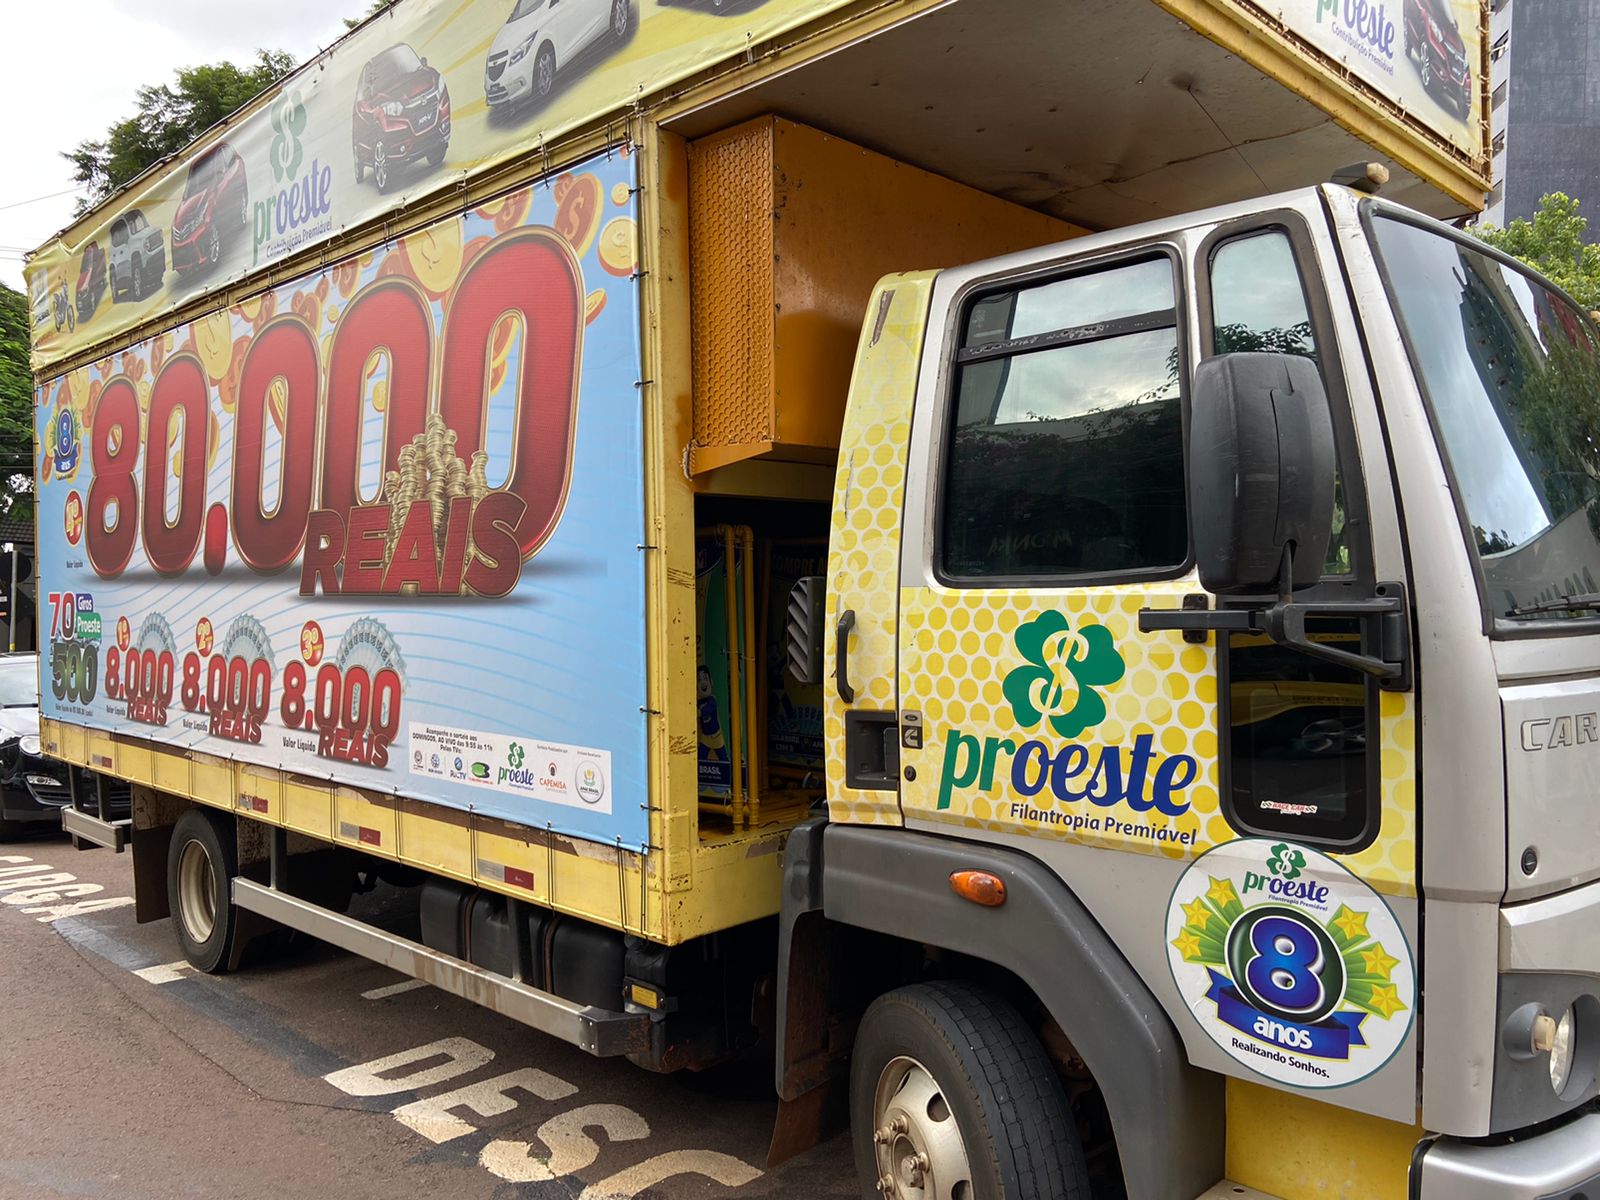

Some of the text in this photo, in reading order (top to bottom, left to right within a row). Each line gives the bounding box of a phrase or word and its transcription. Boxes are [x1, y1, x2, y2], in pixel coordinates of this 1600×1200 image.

[253, 158, 332, 267] proeste
[85, 224, 586, 580] 80.000
[299, 490, 528, 598] REAIS
[48, 592, 93, 640] 70 Giros
[77, 615, 101, 635] Proeste
[52, 642, 98, 705] 500
[105, 646, 174, 708] 8.000
[181, 651, 272, 726] 8.000
[126, 697, 168, 727] REAIS
[280, 660, 402, 743] 8.000
[209, 708, 262, 745] REAIS
[283, 736, 296, 749] Valor
[318, 725, 389, 769] REAIS
[497, 766, 535, 786] proeste
[539, 777, 567, 790] CAPEMISA
[937, 729, 1197, 817] proeste
[1010, 803, 1197, 845] Filantropia Premiável
[0, 855, 136, 923] ARGA
[1242, 871, 1330, 904] proeste
[1268, 895, 1299, 905] Filantropia
[1246, 915, 1325, 1014] 8
[1253, 1016, 1313, 1050] anos
[1232, 1038, 1330, 1078] Realizando Sonhos.
